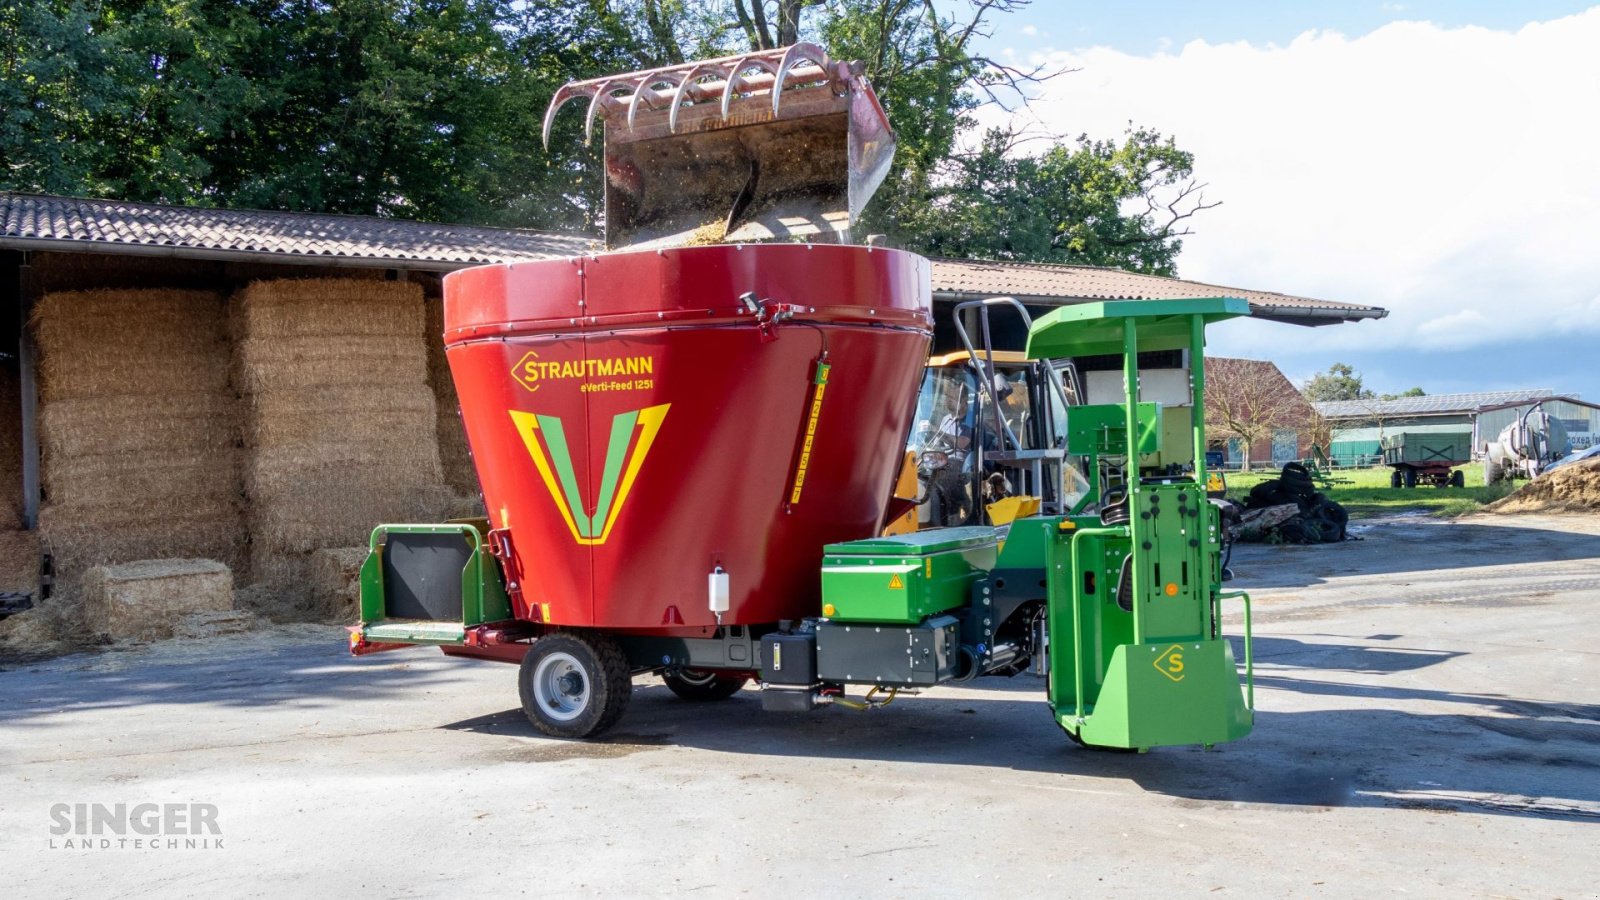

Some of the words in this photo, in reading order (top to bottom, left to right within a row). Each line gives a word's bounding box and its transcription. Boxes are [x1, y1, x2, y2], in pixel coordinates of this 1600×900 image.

[524, 356, 653, 382] STRAUTMANN
[580, 380, 633, 393] eVerti-Feed
[634, 379, 654, 390] 1251
